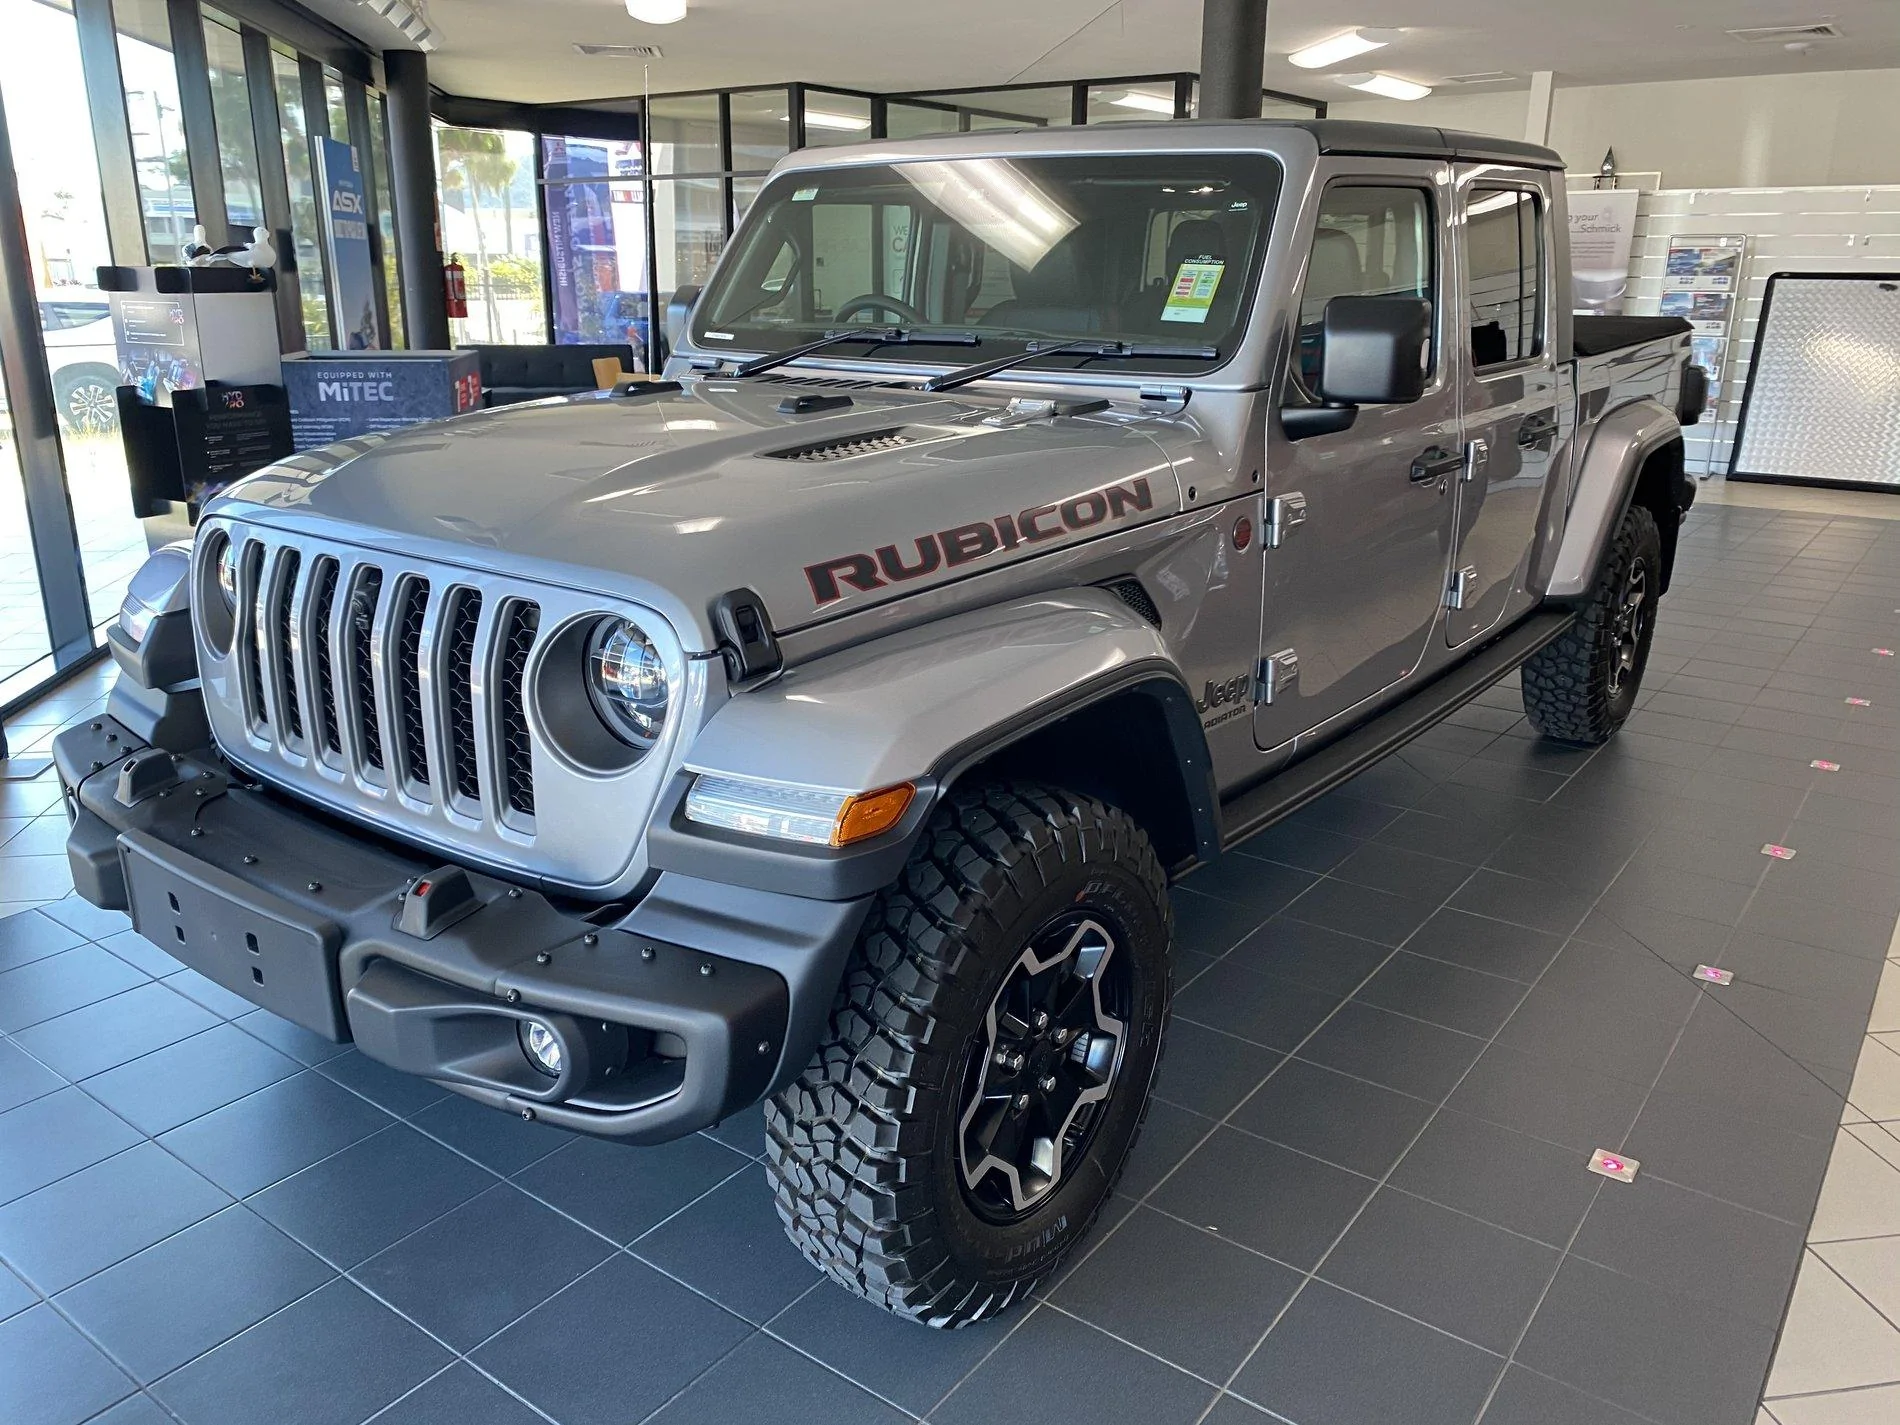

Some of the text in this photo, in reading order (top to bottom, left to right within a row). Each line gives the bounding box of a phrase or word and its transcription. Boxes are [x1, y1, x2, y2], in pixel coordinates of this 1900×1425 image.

[332, 190, 363, 214] ASX
[1575, 214, 1599, 223] your
[317, 371, 393, 379] EQUIPPED WITH
[318, 381, 395, 402] MiTEC
[803, 477, 1154, 606] RUBICON
[1195, 673, 1250, 714] Jeep
[1203, 704, 1246, 730] ADIATOR
